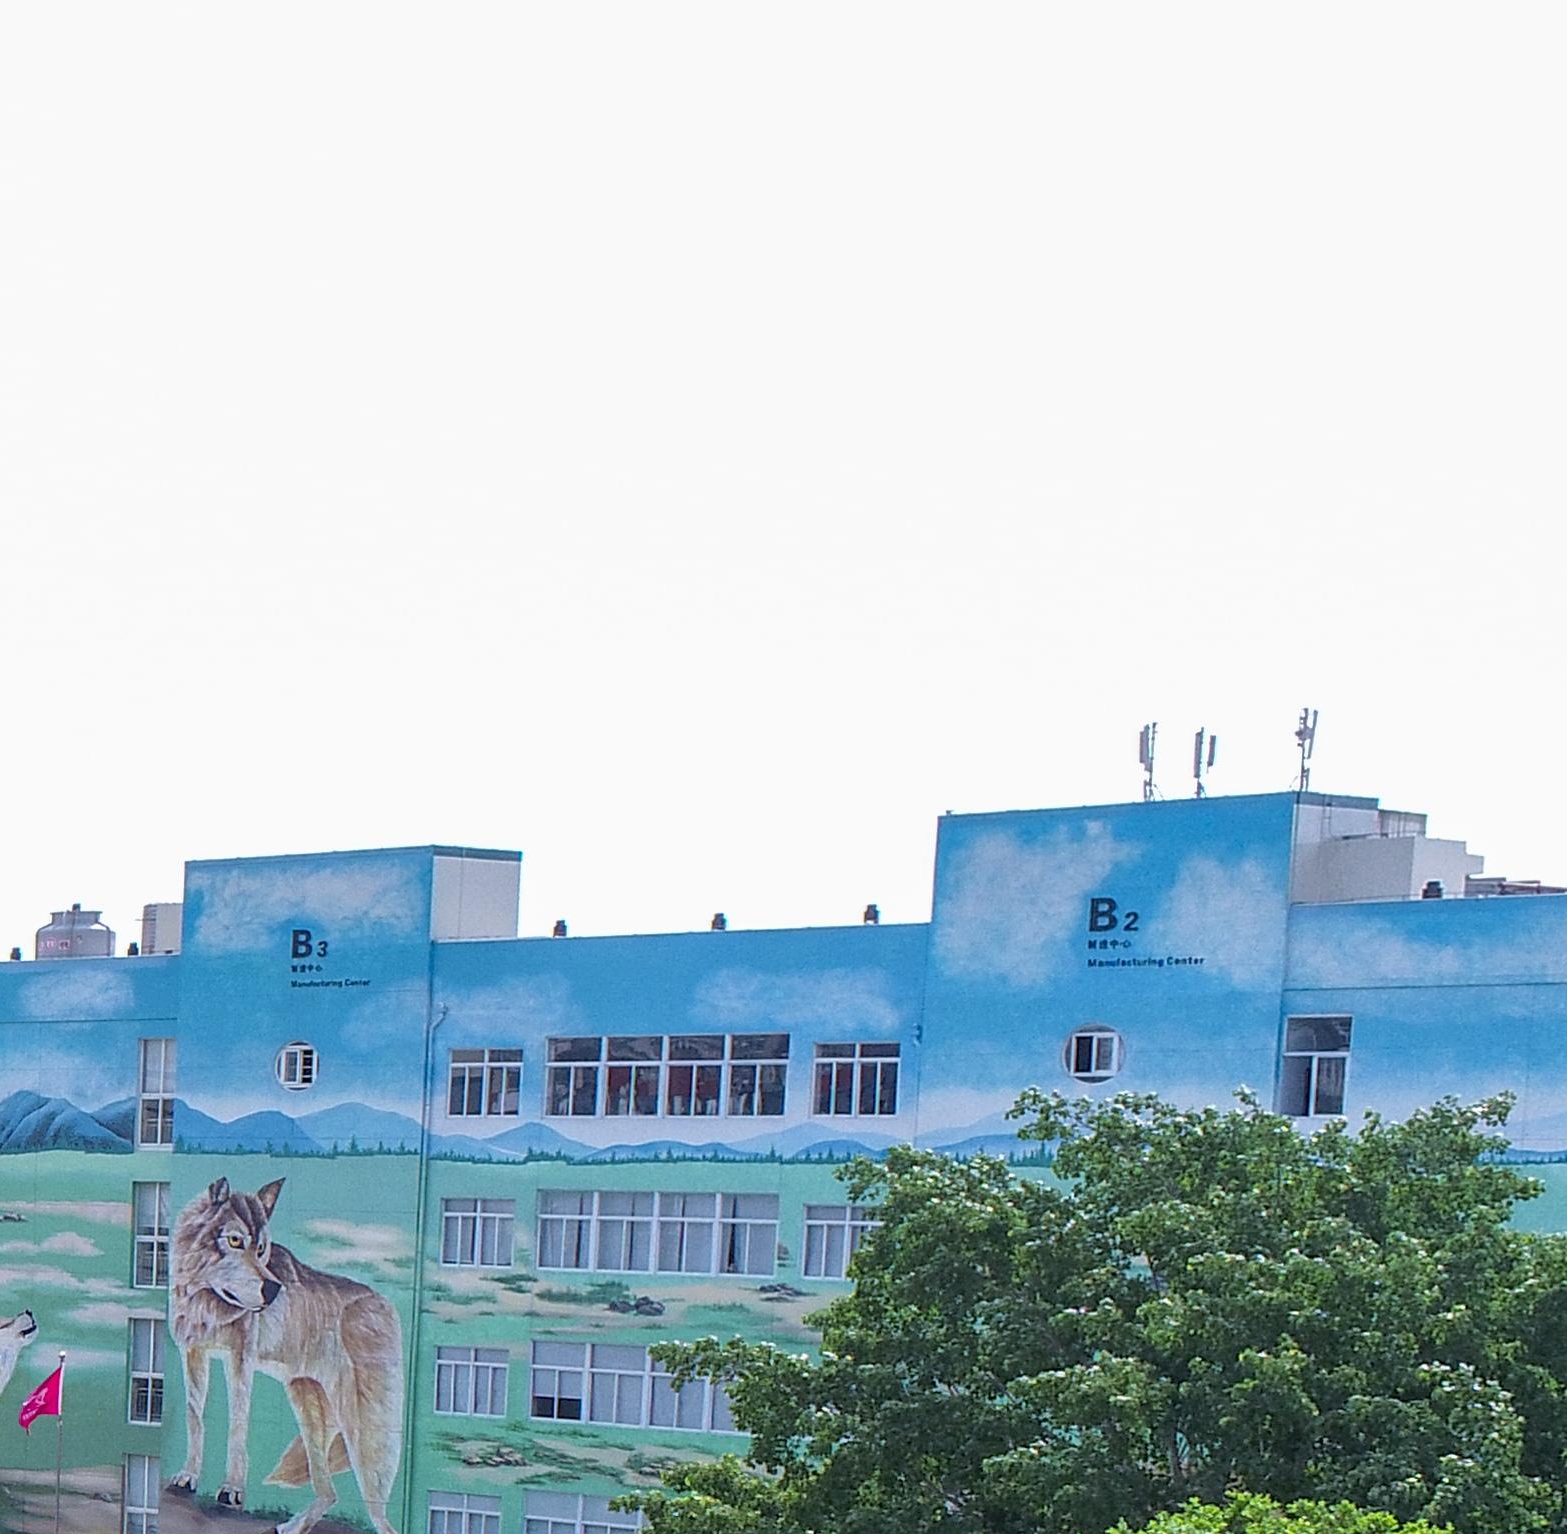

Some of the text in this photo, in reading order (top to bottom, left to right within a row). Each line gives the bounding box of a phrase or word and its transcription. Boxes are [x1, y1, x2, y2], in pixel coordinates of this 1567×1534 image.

[1088, 897, 1140, 932] B2
[290, 929, 329, 959] B3
[1087, 956, 1206, 968] Manufacturing Center
